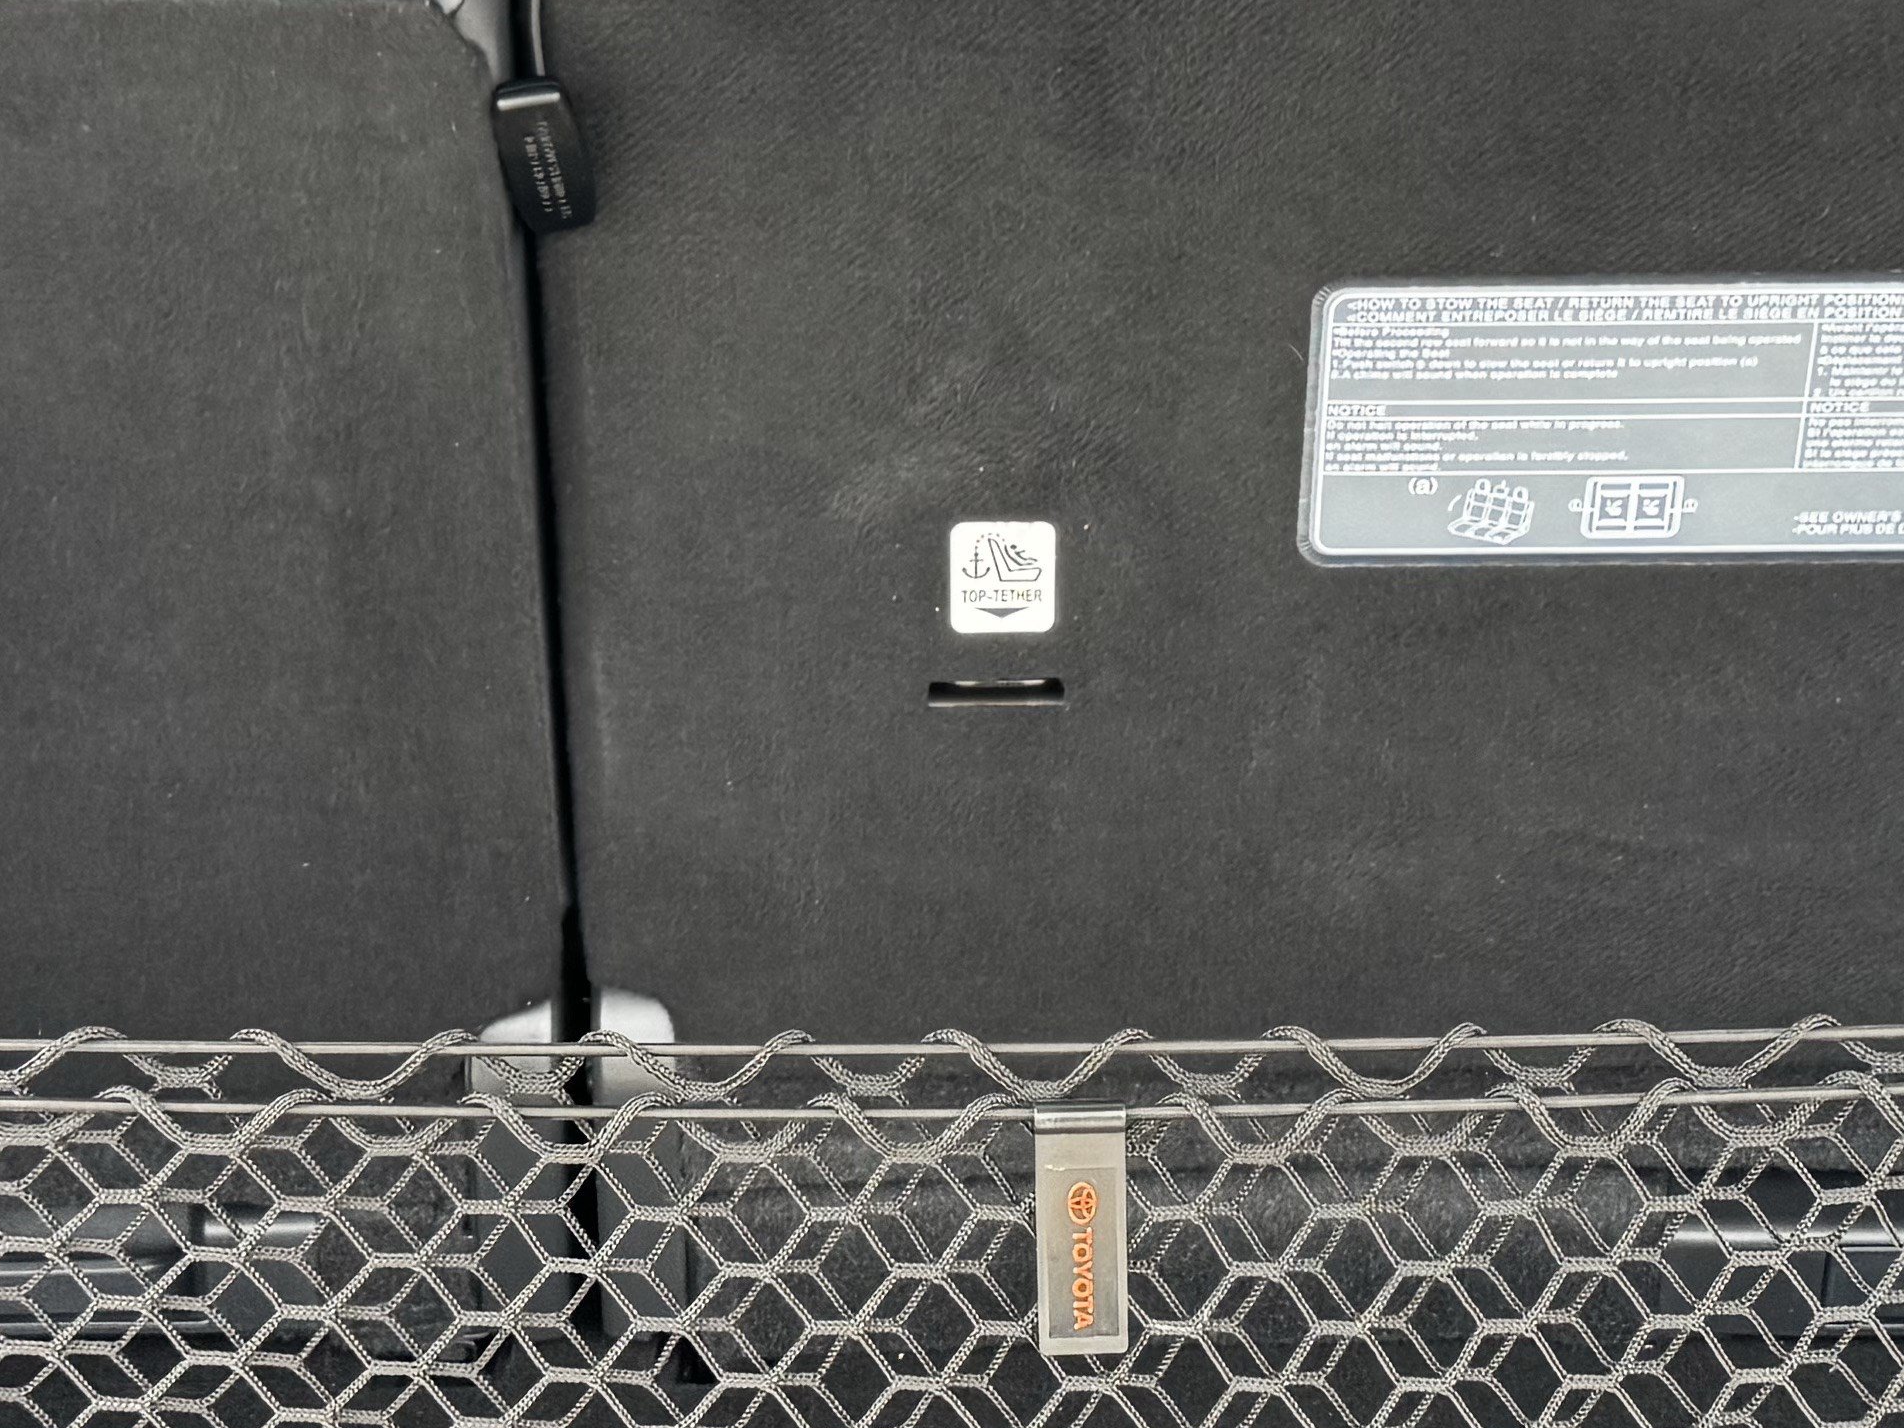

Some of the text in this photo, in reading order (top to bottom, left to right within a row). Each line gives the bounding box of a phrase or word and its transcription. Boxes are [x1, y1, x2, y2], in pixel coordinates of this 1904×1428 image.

[1327, 405, 1386, 415] NOTICE
[1406, 476, 1440, 494] (a)
[962, 589, 1042, 603] TOP-TETHER
[1072, 1226, 1095, 1331] TOYOTA
